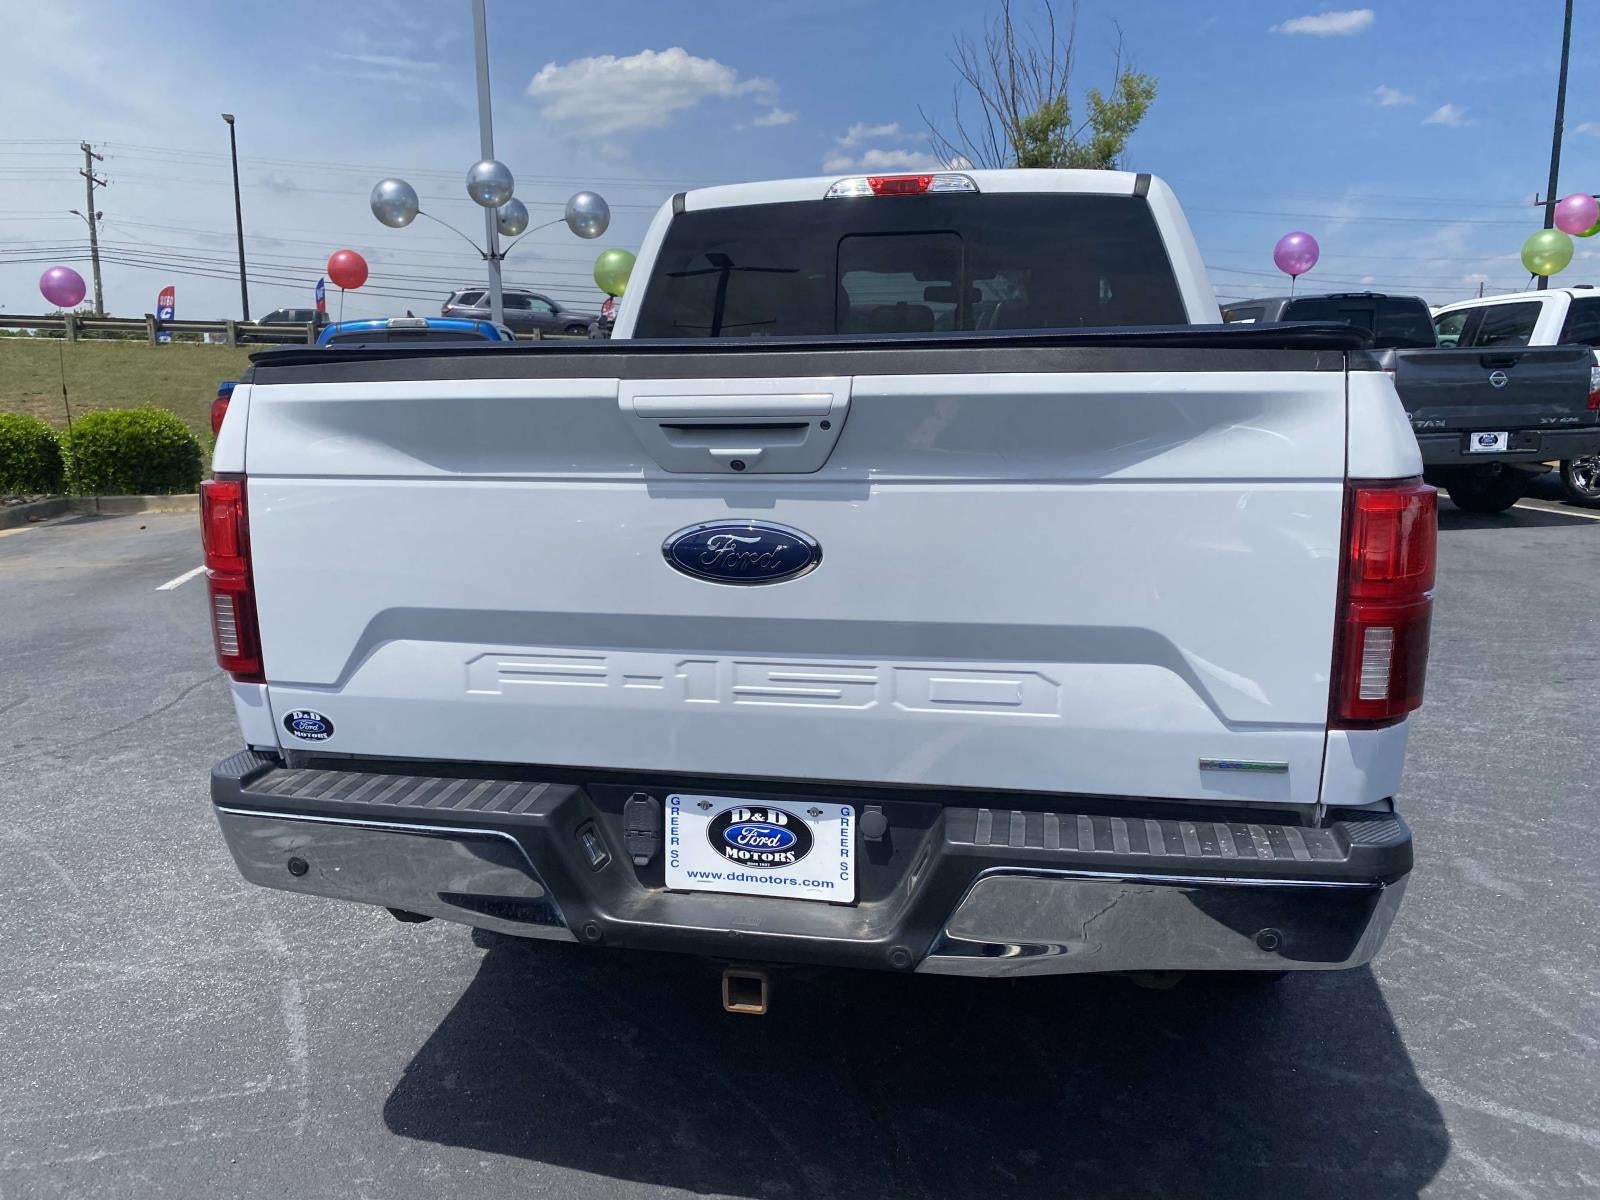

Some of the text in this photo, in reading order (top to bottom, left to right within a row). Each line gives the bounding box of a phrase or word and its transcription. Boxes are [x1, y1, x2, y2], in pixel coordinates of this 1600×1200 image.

[701, 534, 787, 569] Ford
[292, 711, 321, 721] D&D
[294, 730, 328, 739] MOTORS
[299, 721, 319, 731] Ford
[730, 808, 788, 826] D&D
[670, 796, 681, 868] GREER SC
[737, 826, 782, 848] Ford
[839, 807, 850, 881] GREER SC
[725, 846, 796, 862] MOTORS
[687, 870, 834, 889] www.ddmotors.com
